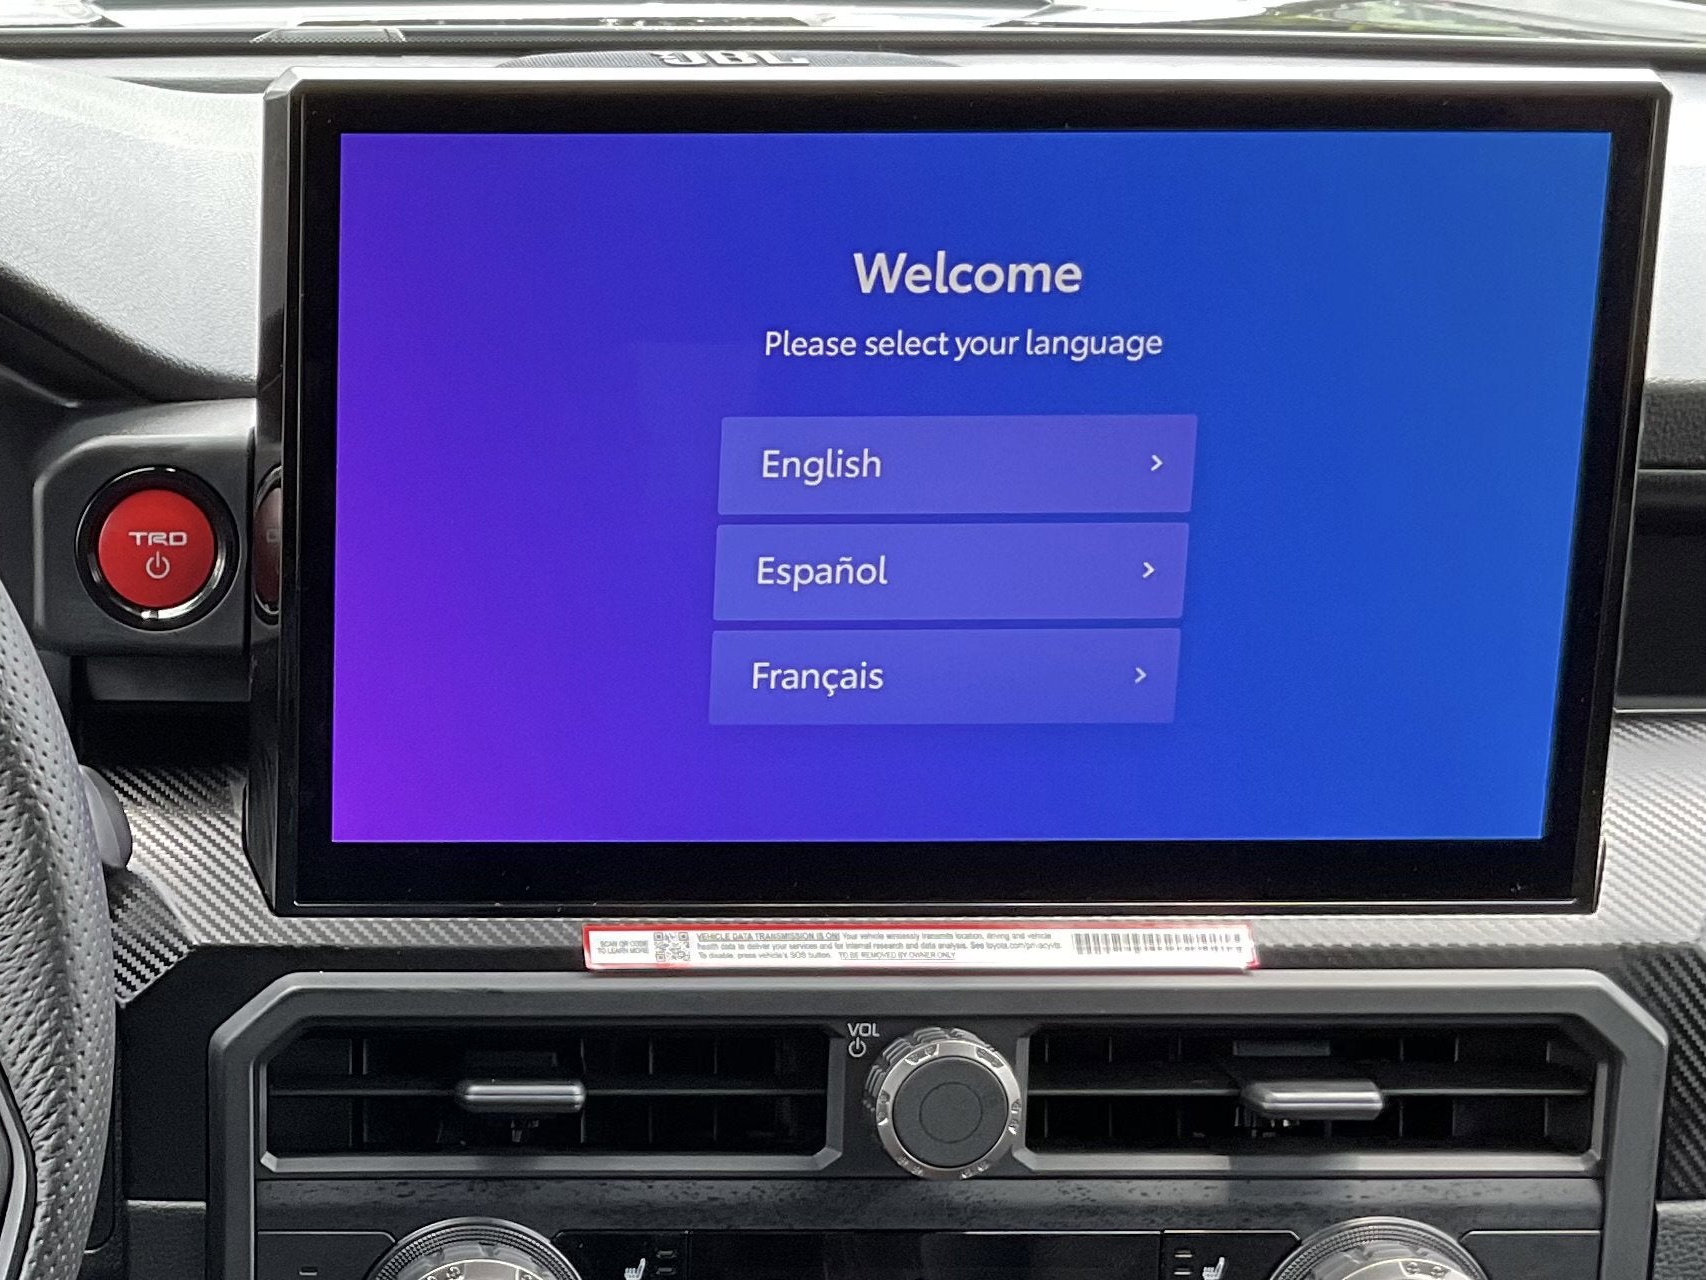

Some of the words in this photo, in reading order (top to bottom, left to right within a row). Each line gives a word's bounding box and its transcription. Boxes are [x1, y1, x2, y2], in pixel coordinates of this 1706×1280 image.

[660, 50, 809, 67] JBL
[853, 250, 1083, 294] Welcome
[764, 330, 857, 357] Please
[864, 330, 949, 357] select
[954, 332, 1020, 361] your
[1025, 329, 1163, 361] language
[761, 448, 882, 486] English
[128, 531, 188, 546] TRD
[756, 554, 888, 592] Español
[751, 661, 884, 697] Français
[697, 932, 731, 941] VEHICLE
[733, 932, 753, 941] DATA
[755, 932, 814, 941] TRANSMISSION
[861, 932, 884, 941] vehicle
[1012, 932, 1025, 941] and
[720, 942, 736, 950] data
[738, 942, 745, 950] to
[772, 942, 787, 950] your
[789, 942, 818, 950] services
[820, 942, 832, 950] and
[873, 942, 904, 950] research
[906, 942, 919, 950] and
[920, 942, 936, 950] data
[970, 942, 984, 950] See
[790, 951, 806, 959] SOS
[847, 1022, 880, 1038] VOL
